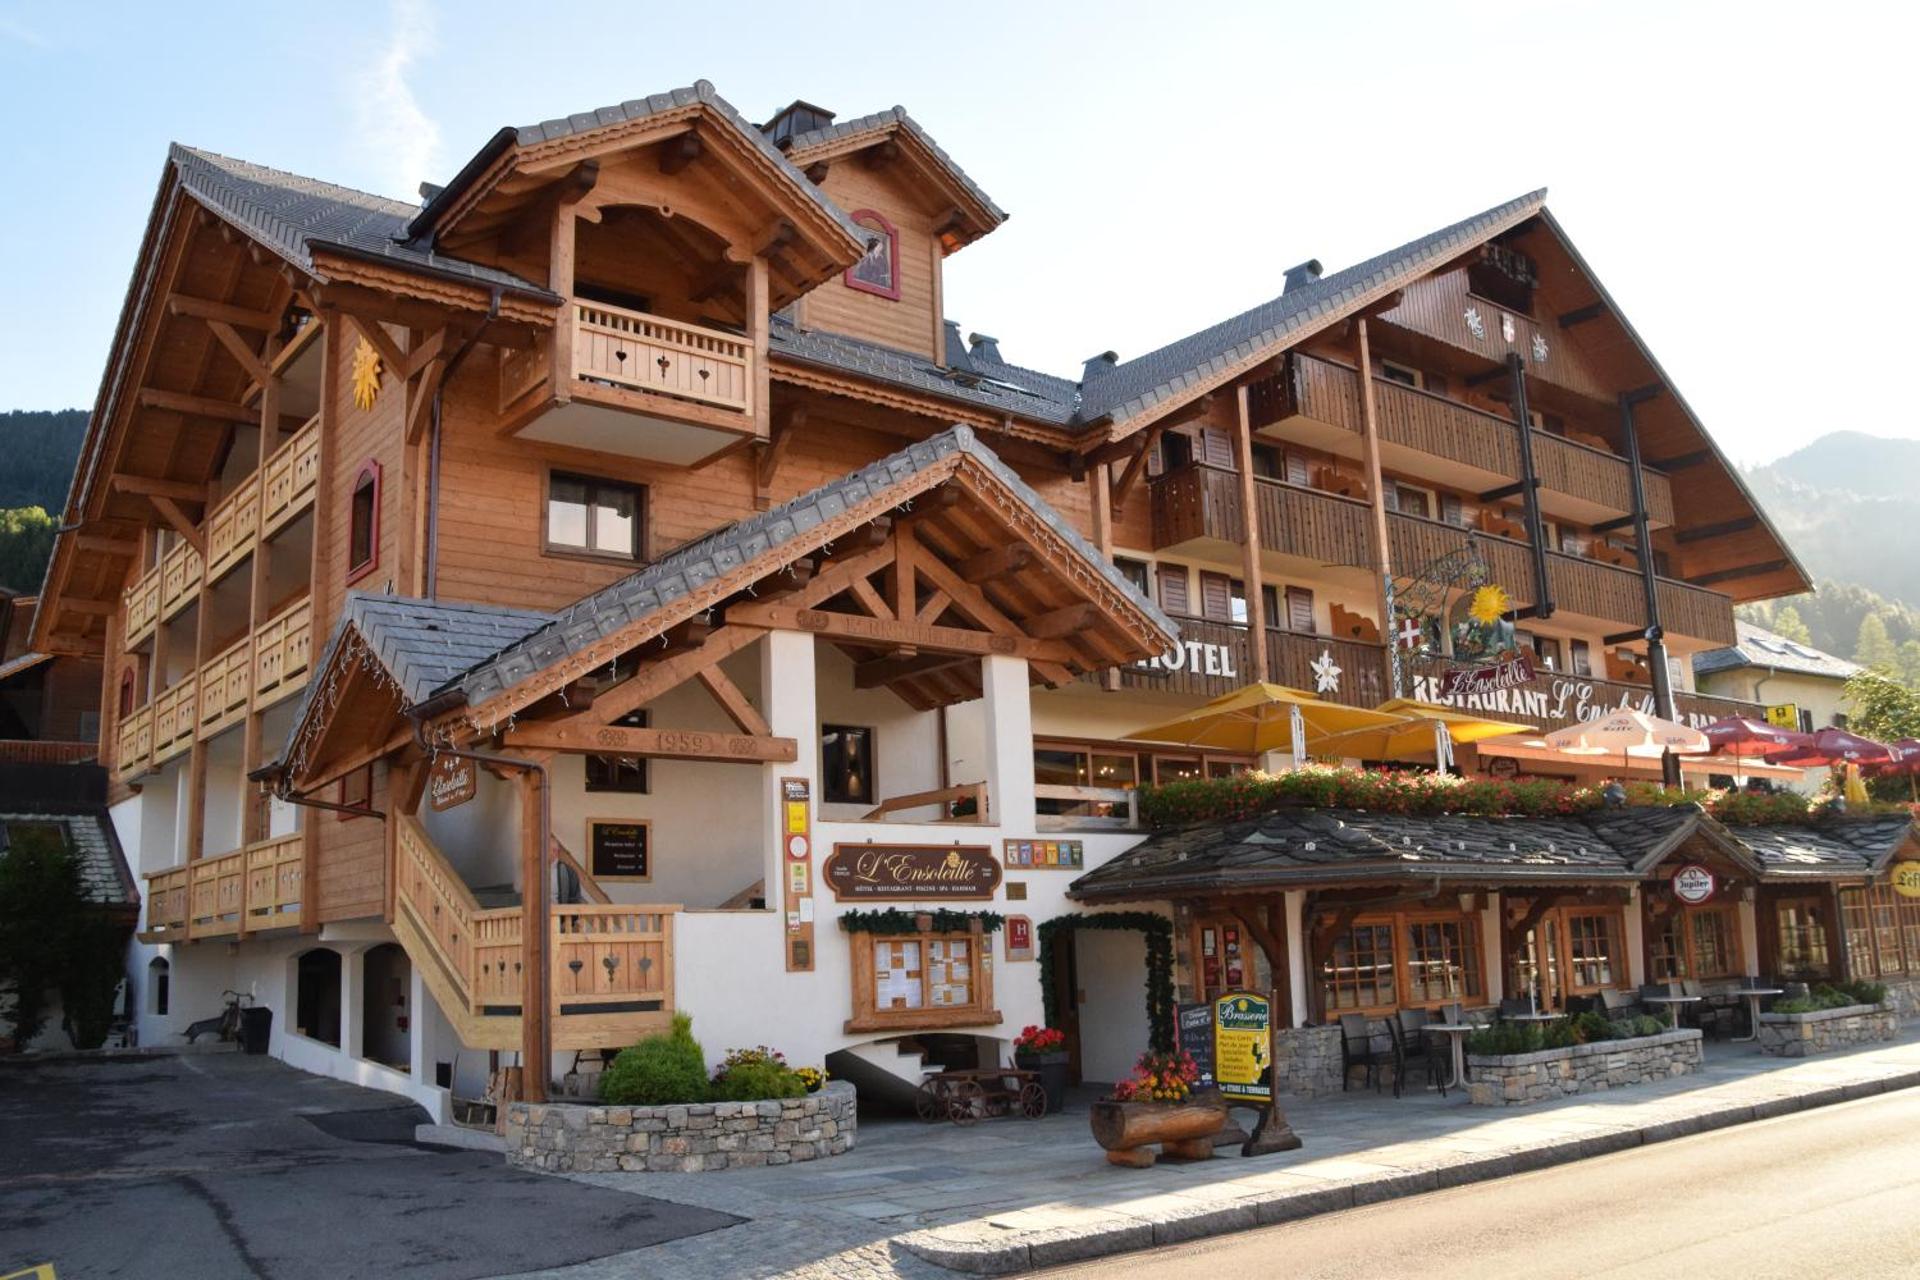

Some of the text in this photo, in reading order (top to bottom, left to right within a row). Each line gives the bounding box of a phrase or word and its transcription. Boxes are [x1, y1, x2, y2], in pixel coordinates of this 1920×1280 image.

[1137, 639, 1237, 677] OTEL
[856, 851, 977, 884] L'Ensoleillé
[1680, 879, 1709, 889] Jupiler
[1017, 923, 1027, 935] H
[1220, 1003, 1268, 1021] Brasserie
